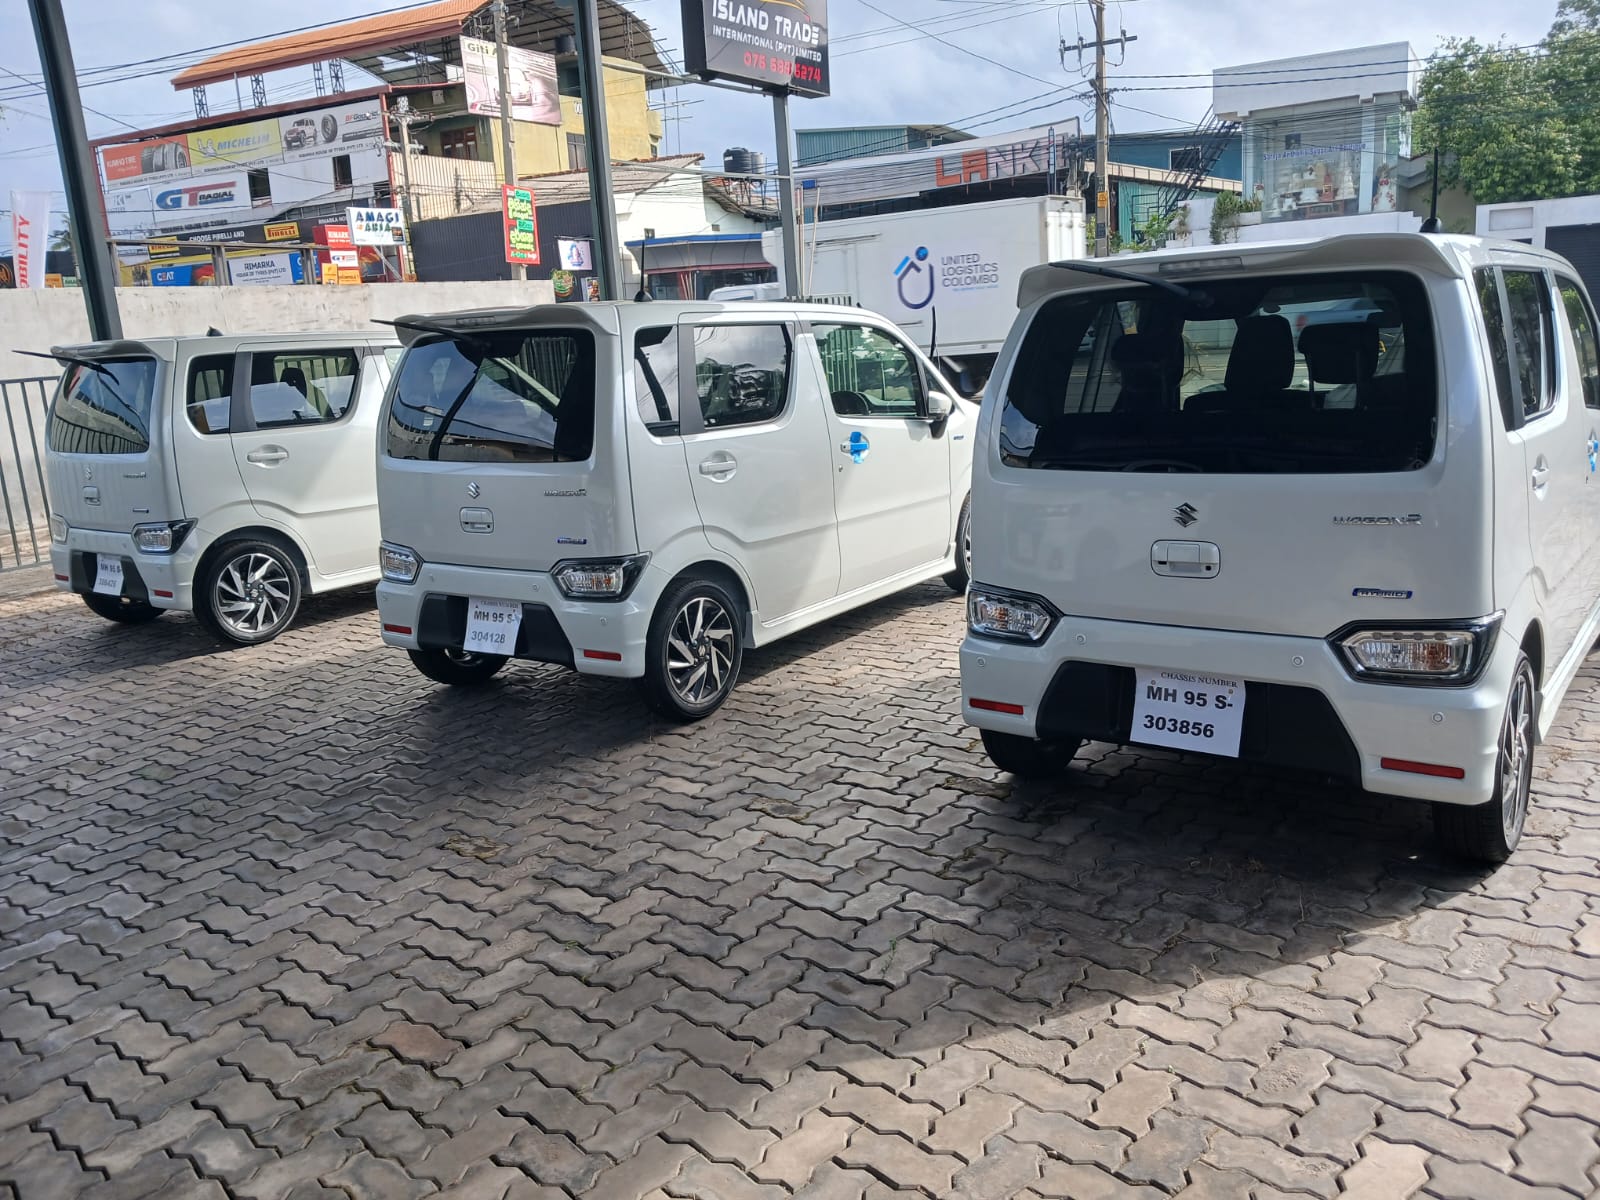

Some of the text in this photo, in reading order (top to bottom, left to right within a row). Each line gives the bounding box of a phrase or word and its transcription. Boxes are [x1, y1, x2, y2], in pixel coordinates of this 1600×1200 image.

[712, 0, 820, 45] ISLAND TRADE
[467, 43, 489, 55] Giti
[712, 24, 822, 62] INTERNATIONAL (PVT) LIMITED
[794, 63, 822, 82] 6274
[217, 133, 269, 150] MICHELIN
[936, 132, 1067, 187] LANKA
[198, 190, 234, 201] RADIAL
[356, 211, 399, 223] AMAGI
[212, 231, 232, 239] PIRELLI
[233, 230, 245, 238] AND
[267, 225, 296, 238] PIRELLI
[244, 260, 275, 271] RIMARKA
[941, 253, 980, 265] UNITED
[157, 271, 174, 281] CEAT
[942, 263, 998, 276] LOGISTICS
[942, 273, 999, 287] COLOMBO
[473, 610, 489, 621] MH
[492, 612, 504, 623] 95
[471, 630, 506, 644] 304128
[1160, 671, 1238, 688] CHASSIS NUMBER
[1146, 685, 1178, 702] MH
[1184, 690, 1208, 707] 95
[1143, 714, 1215, 738] 303856
